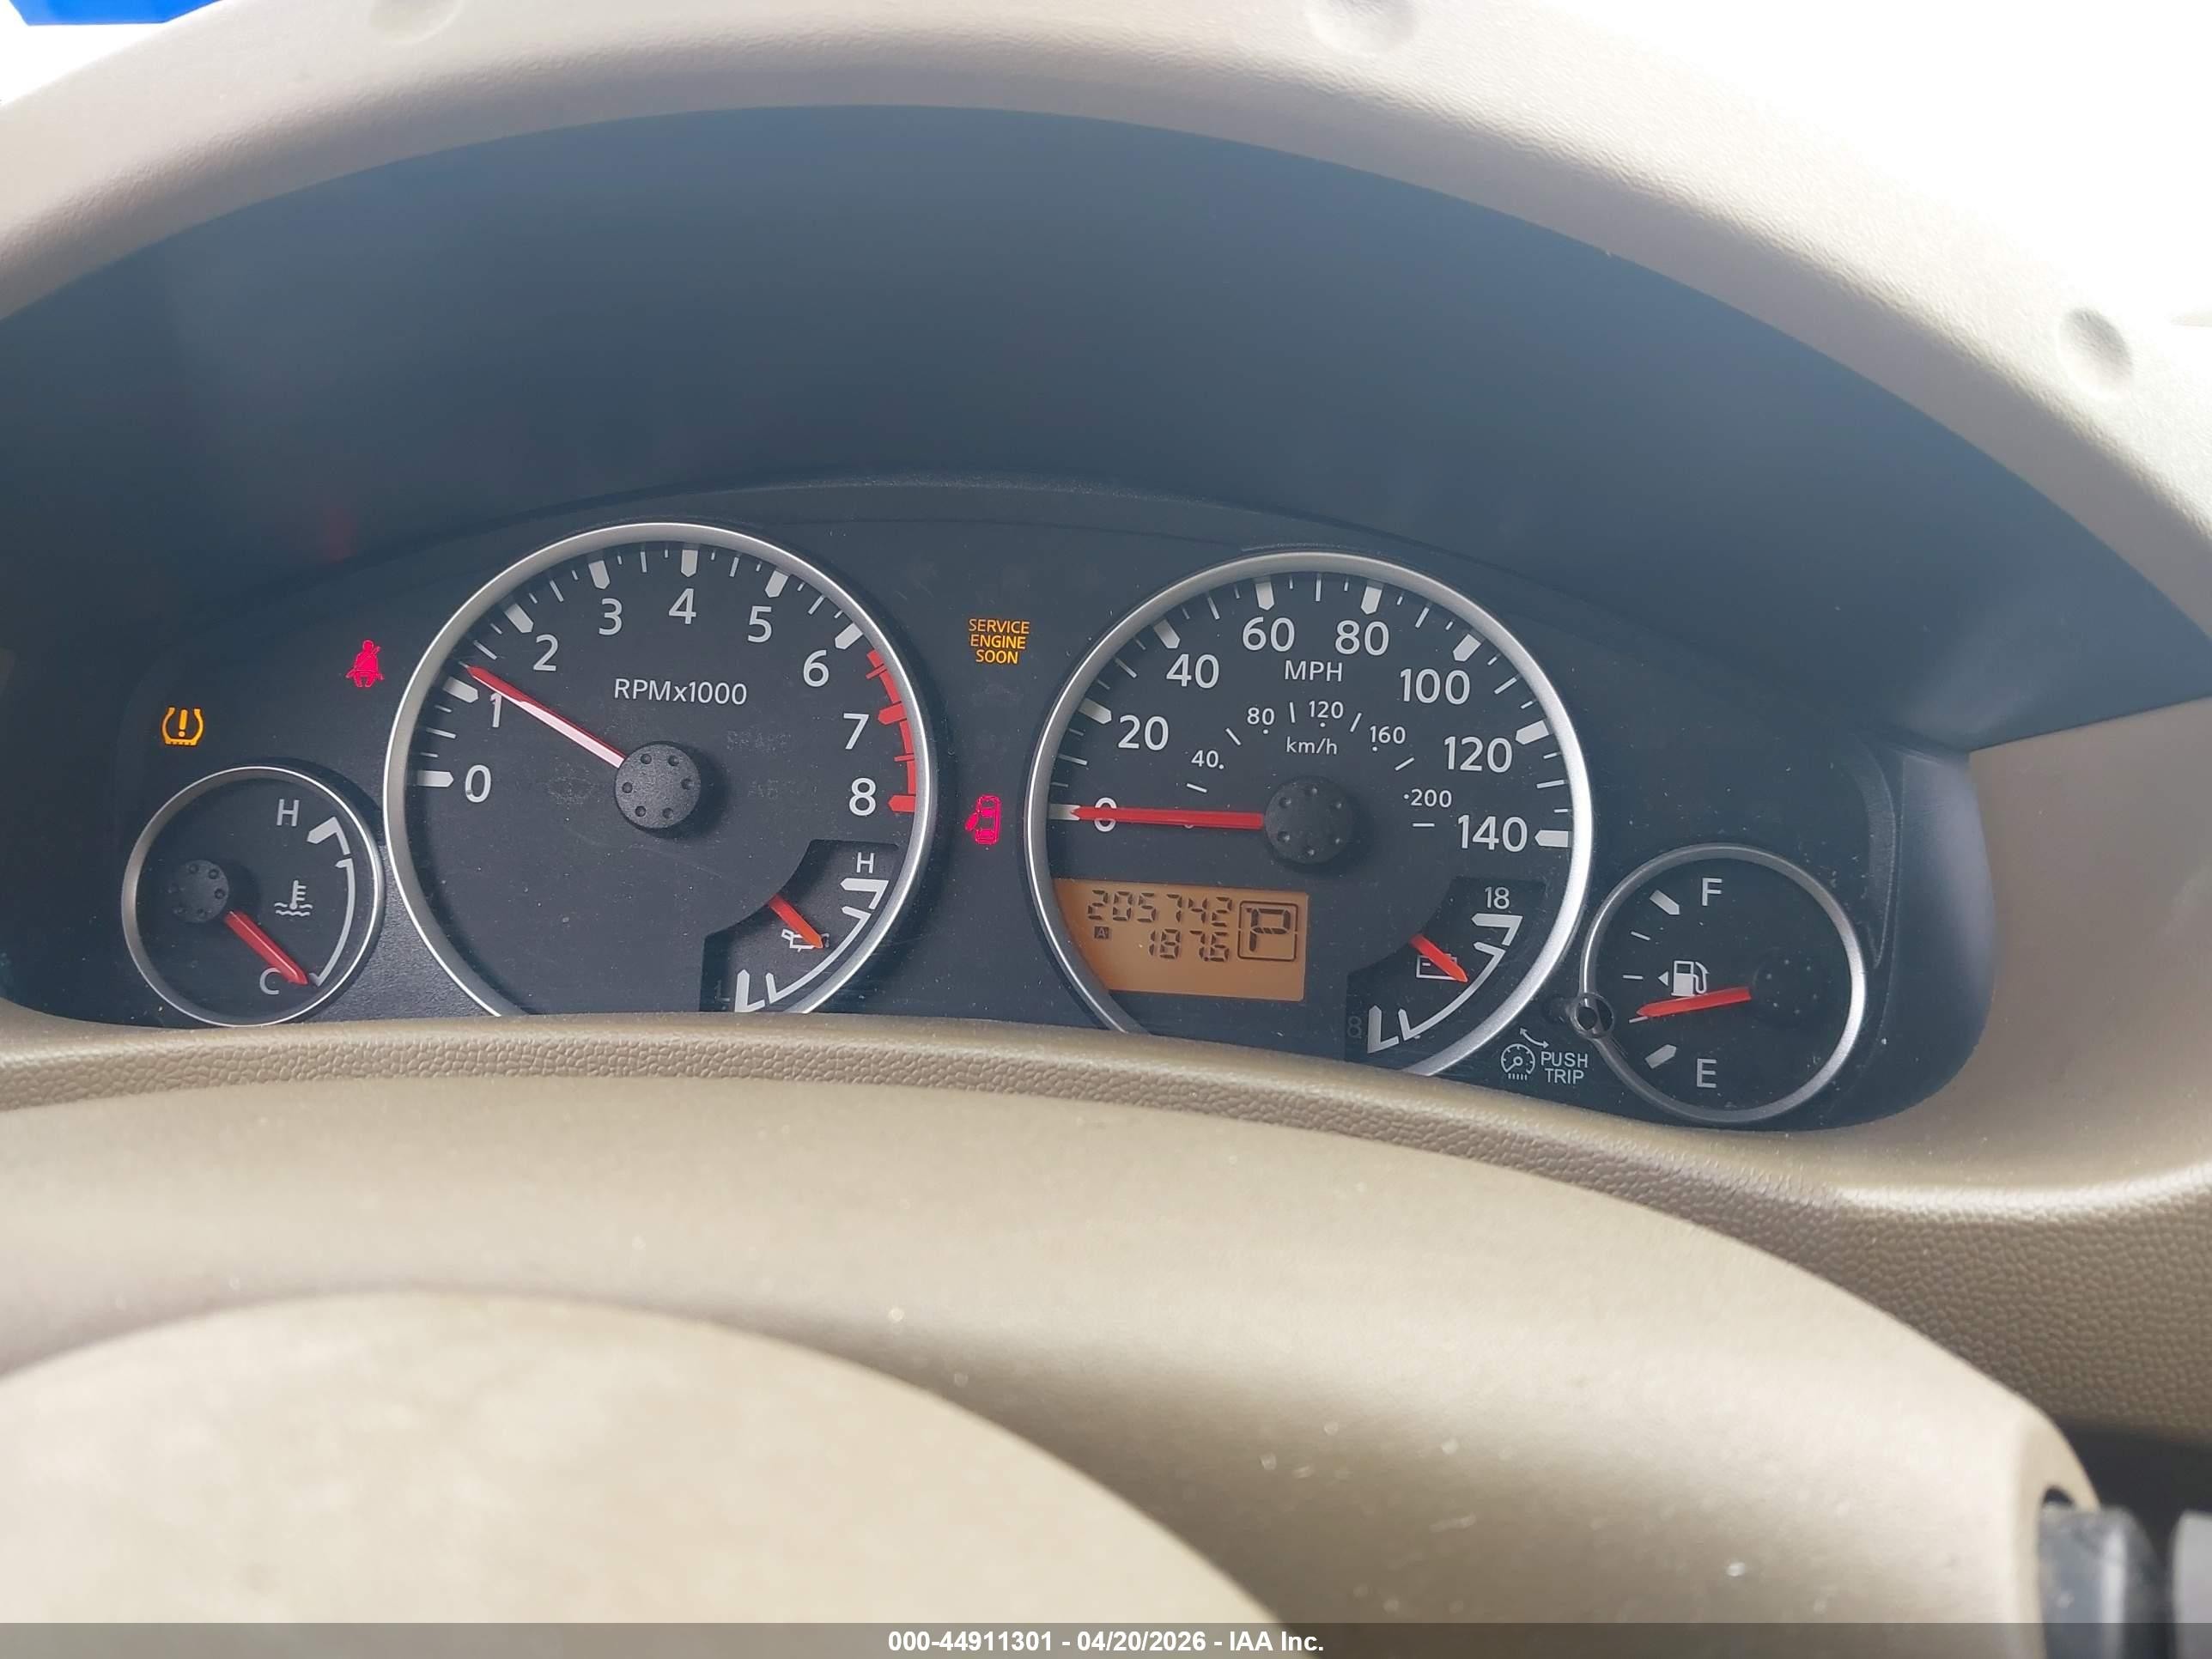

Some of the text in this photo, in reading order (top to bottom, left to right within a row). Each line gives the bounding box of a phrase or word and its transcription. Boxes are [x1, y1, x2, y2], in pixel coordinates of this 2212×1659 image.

[599, 598, 623, 635] 3
[669, 588, 696, 624] 4
[747, 605, 773, 643] 5
[969, 618, 1030, 634] SERVICE
[1242, 617, 1295, 652] 60
[1335, 621, 1389, 656] 80
[533, 634, 559, 672] 2
[970, 634, 1026, 649] ENGINE
[975, 649, 1018, 664] SOON
[803, 649, 830, 688] 6
[1165, 654, 1220, 689] 40
[1284, 660, 1344, 683] MPH
[613, 678, 748, 706] RPMx1000
[1400, 668, 1471, 705] 100
[489, 691, 503, 728] 1
[1247, 707, 1276, 726] 80
[1308, 702, 1345, 720] 120
[843, 714, 870, 750] 7
[1117, 715, 1170, 751] 20
[1286, 736, 1338, 756] km/h
[1370, 726, 1407, 744] 160
[1191, 750, 1219, 769] 40
[1444, 736, 1513, 773] 120
[465, 764, 492, 804] 0
[848, 777, 877, 817] 8
[1411, 788, 1453, 809] 200
[276, 799, 300, 827] H
[1458, 814, 1528, 853] 140
[856, 852, 875, 874] H
[1485, 886, 1511, 908] 18
[1701, 878, 1723, 906] F
[1087, 890, 1232, 927] 205742
[1246, 907, 1291, 952] P
[259, 966, 281, 995] C
[1540, 1051, 1589, 1069] PUSH
[1696, 1058, 1717, 1089] E
[1546, 1067, 1585, 1085] TRIP
